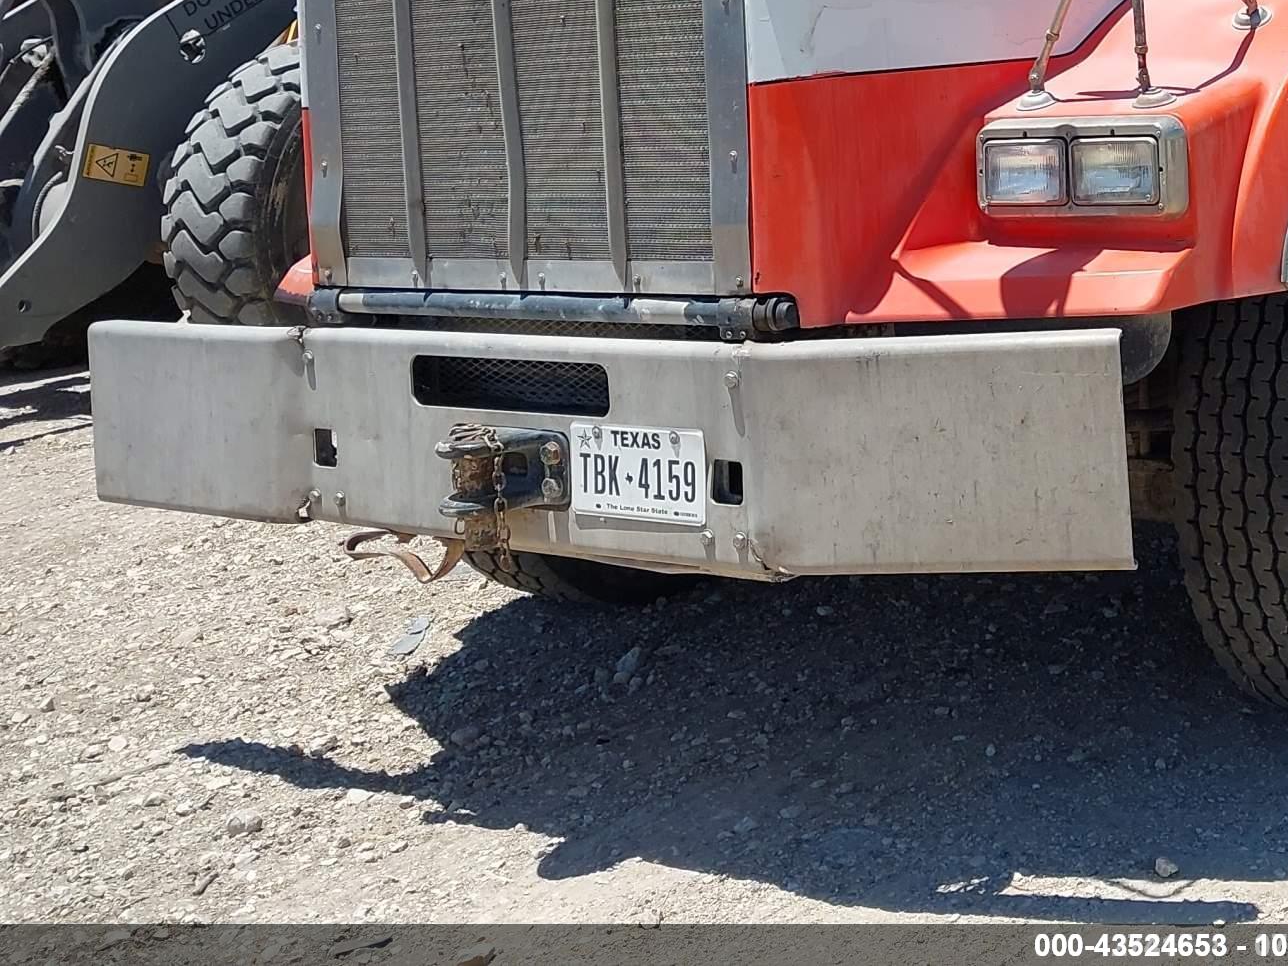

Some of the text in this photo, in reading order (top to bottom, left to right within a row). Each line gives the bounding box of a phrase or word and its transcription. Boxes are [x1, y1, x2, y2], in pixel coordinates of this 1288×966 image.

[610, 430, 661, 450] TEXAS
[580, 453, 696, 503] TBK 4159
[620, 504, 635, 512] Lone
[636, 505, 650, 513] Star
[651, 507, 668, 515] State
